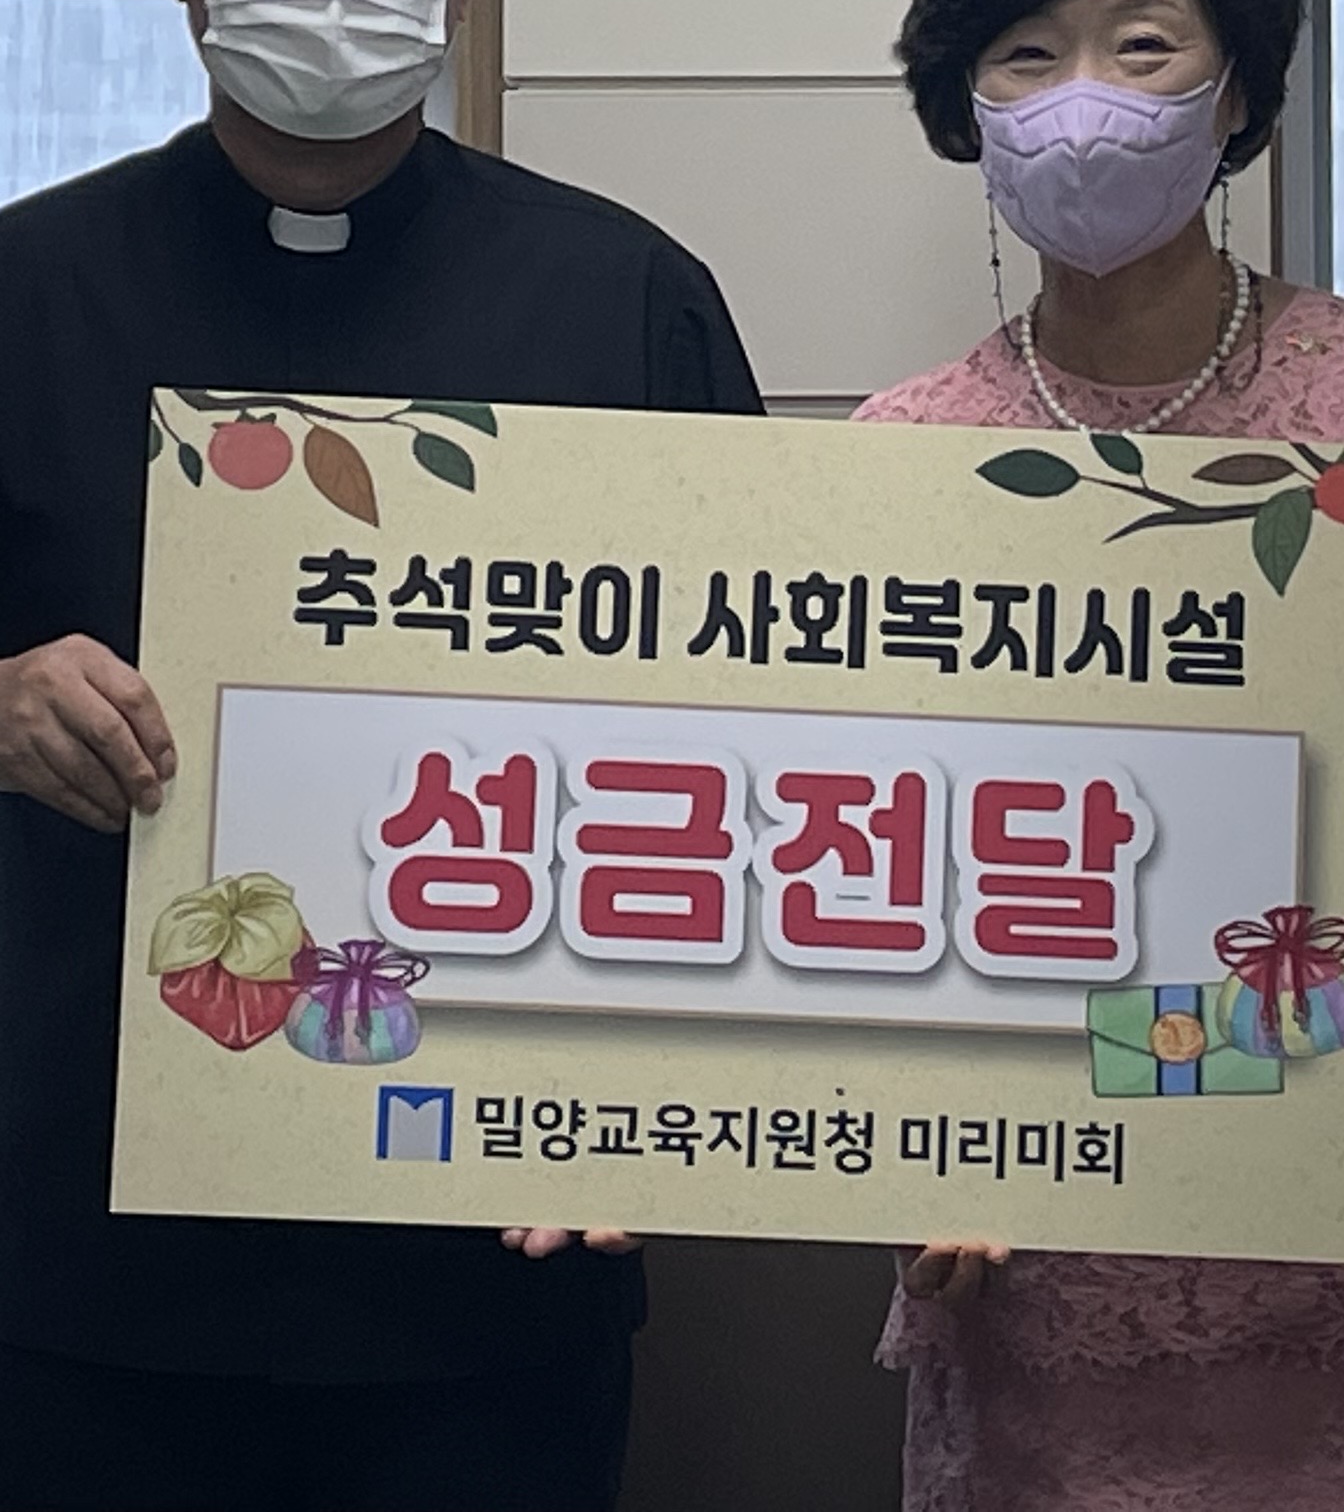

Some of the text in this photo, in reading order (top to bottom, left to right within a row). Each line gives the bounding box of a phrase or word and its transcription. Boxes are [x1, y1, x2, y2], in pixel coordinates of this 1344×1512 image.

[293, 548, 1248, 687] 추석맞이 사회복지시설
[380, 751, 1136, 959] 성금전달
[474, 1094, 1127, 1185] 밀양교육지원청 미리미회
